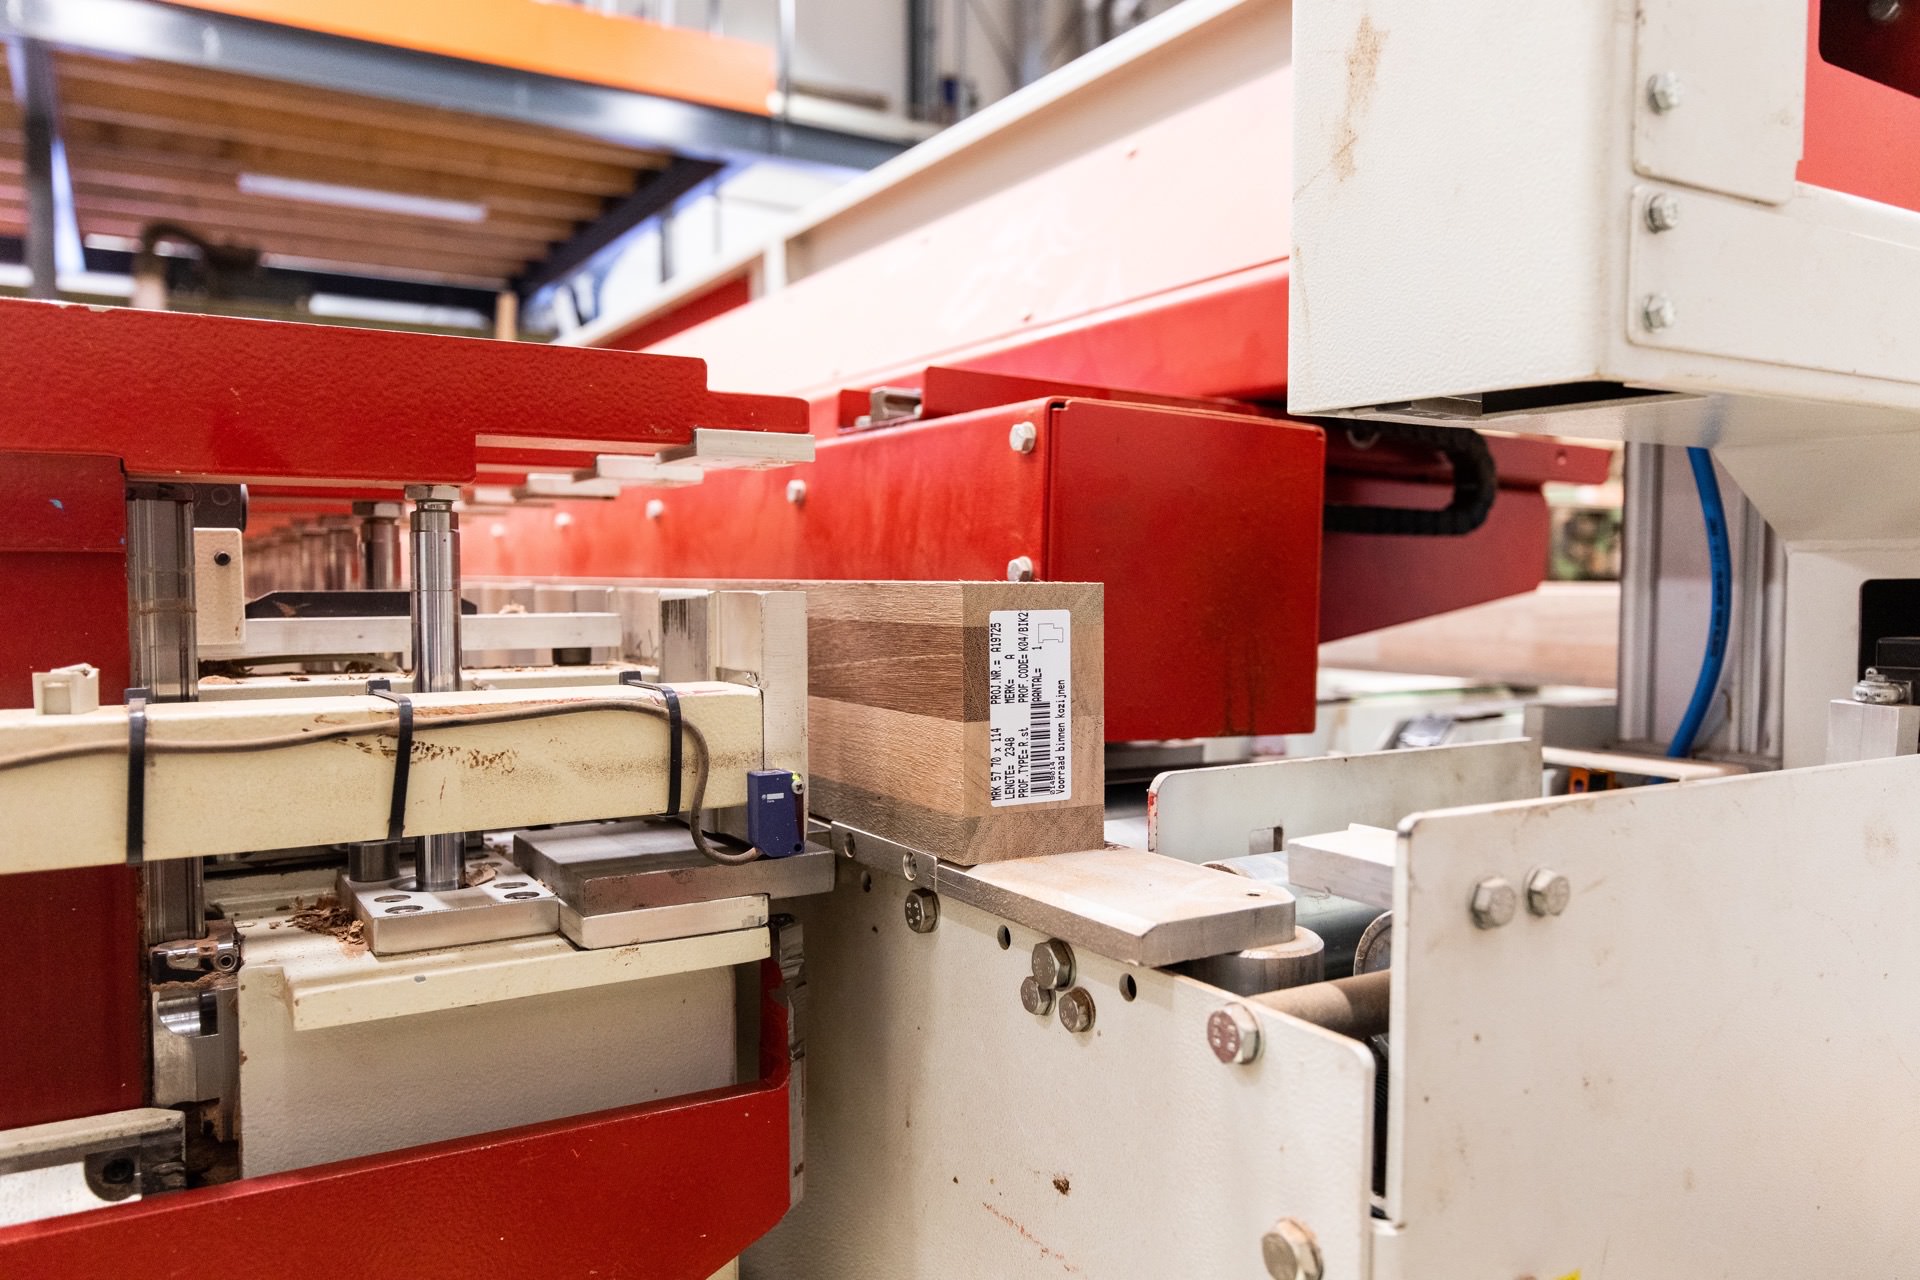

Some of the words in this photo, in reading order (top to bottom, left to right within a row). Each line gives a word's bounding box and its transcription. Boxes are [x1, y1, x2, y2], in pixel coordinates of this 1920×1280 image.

[990, 622, 1002, 653] A19725
[990, 660, 1002, 705] PROJ.NR.=
[1004, 679, 1015, 704] MERK=
[1031, 668, 1042, 702] AANTAL=
[1055, 679, 1067, 719] kozijnen
[991, 727, 1002, 742] 114
[1004, 736, 1015, 757] 2348
[1055, 722, 1065, 752] binnen
[991, 756, 1002, 767] 70
[991, 771, 1002, 781] 57
[1055, 755, 1065, 795] Voorraad
[991, 786, 1002, 800] MRK
[1004, 765, 1015, 800] LENGTE=
